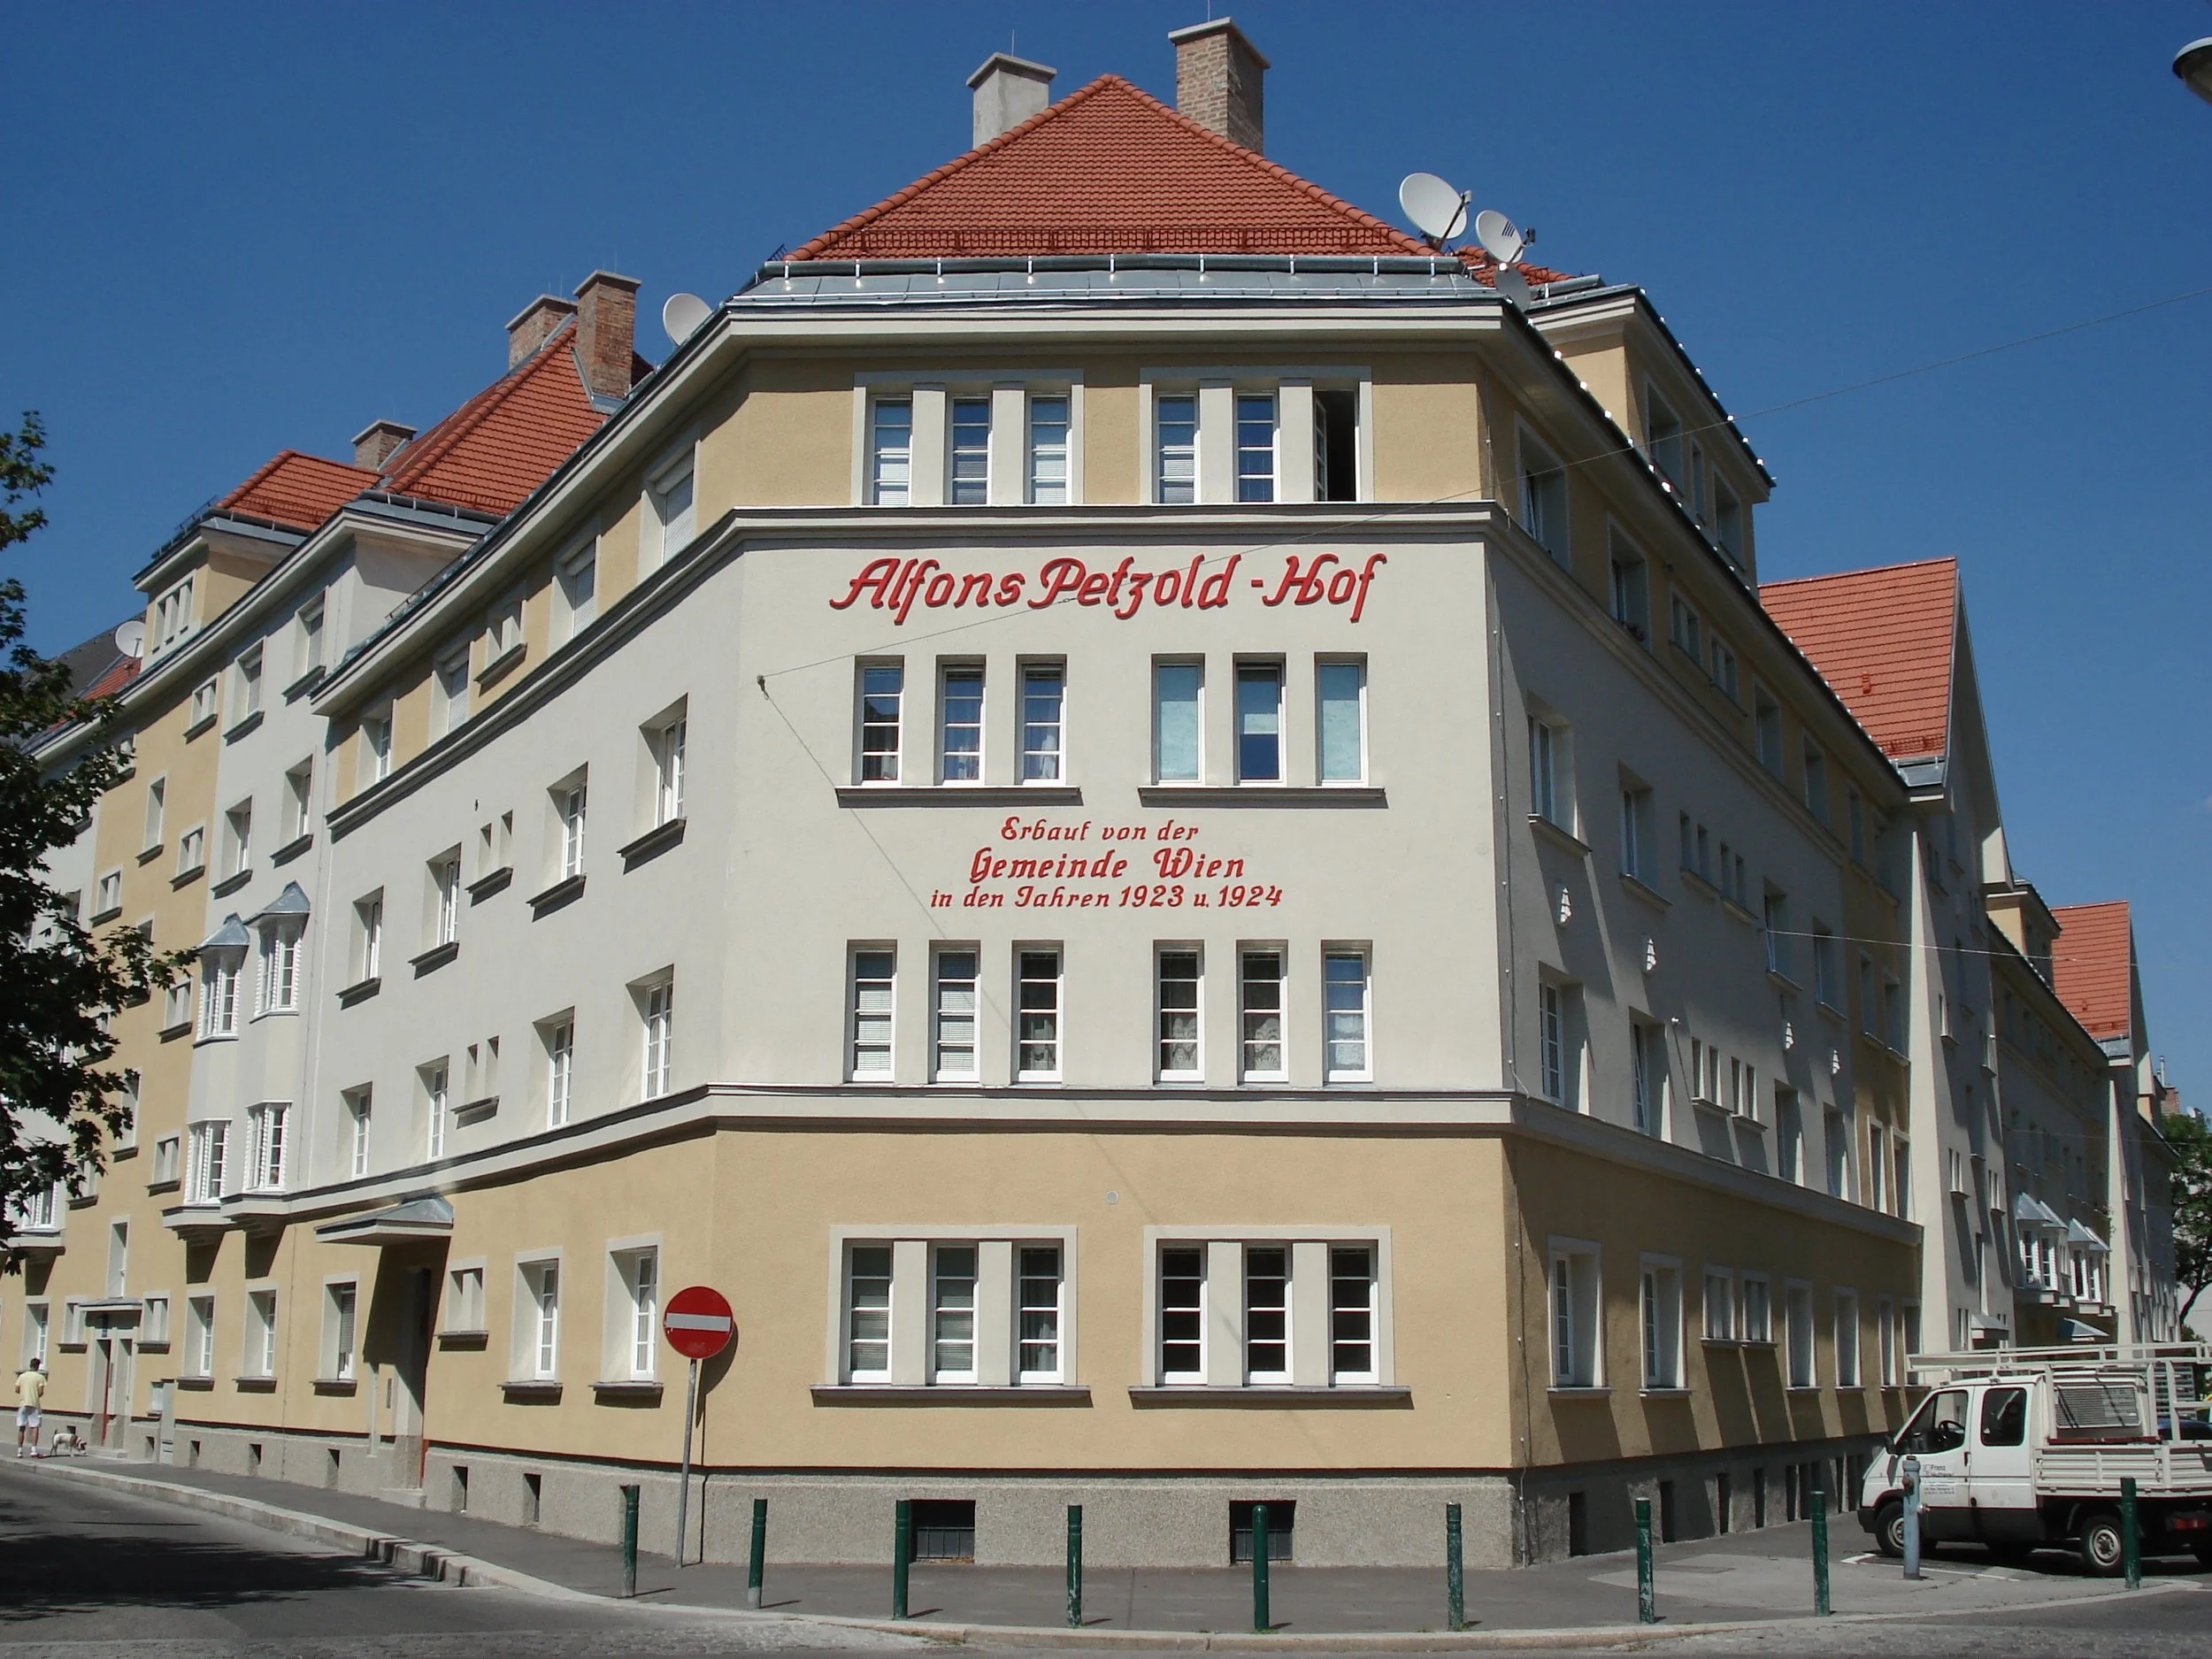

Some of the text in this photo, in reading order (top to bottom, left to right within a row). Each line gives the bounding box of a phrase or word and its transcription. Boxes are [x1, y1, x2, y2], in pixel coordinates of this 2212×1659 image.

[828, 557, 1026, 624] Alfons
[1027, 555, 1242, 619] Petzold
[1001, 815, 1201, 841] Erbaut von der
[968, 846, 1245, 884] Gemeinde Wien
[930, 883, 1283, 908] in den Jahren 1923 u. 1924
